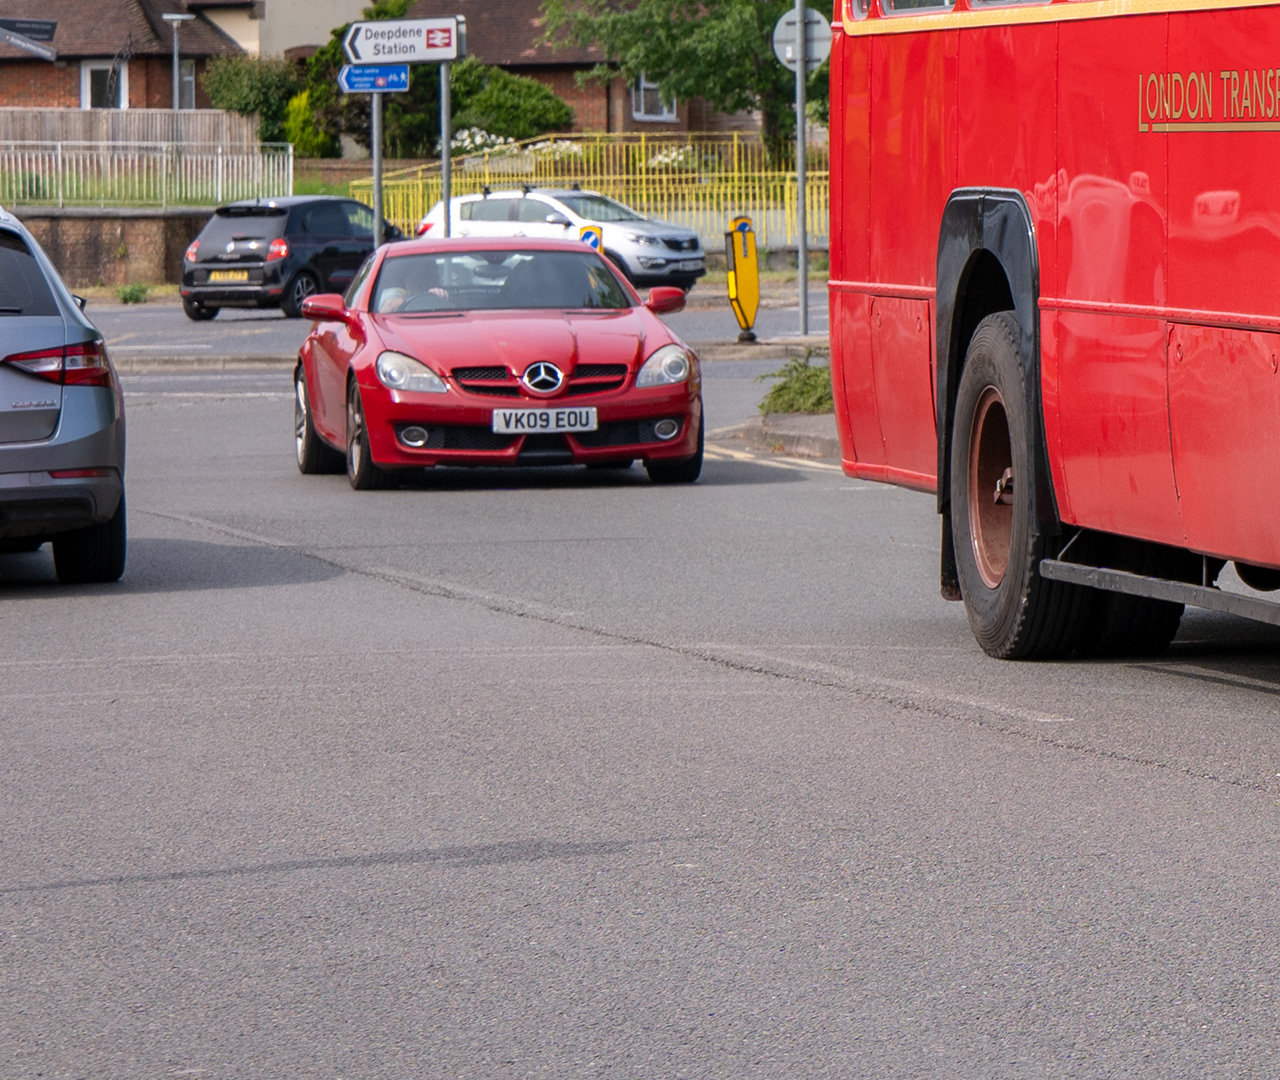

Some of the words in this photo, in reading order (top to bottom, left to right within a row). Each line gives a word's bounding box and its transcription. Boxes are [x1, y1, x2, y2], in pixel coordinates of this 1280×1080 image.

[365, 27, 423, 41] Deepdene
[373, 43, 416, 56] Station
[1138, 71, 1212, 132] LONDON
[503, 411, 550, 429] VK09
[556, 411, 589, 428] EOU
